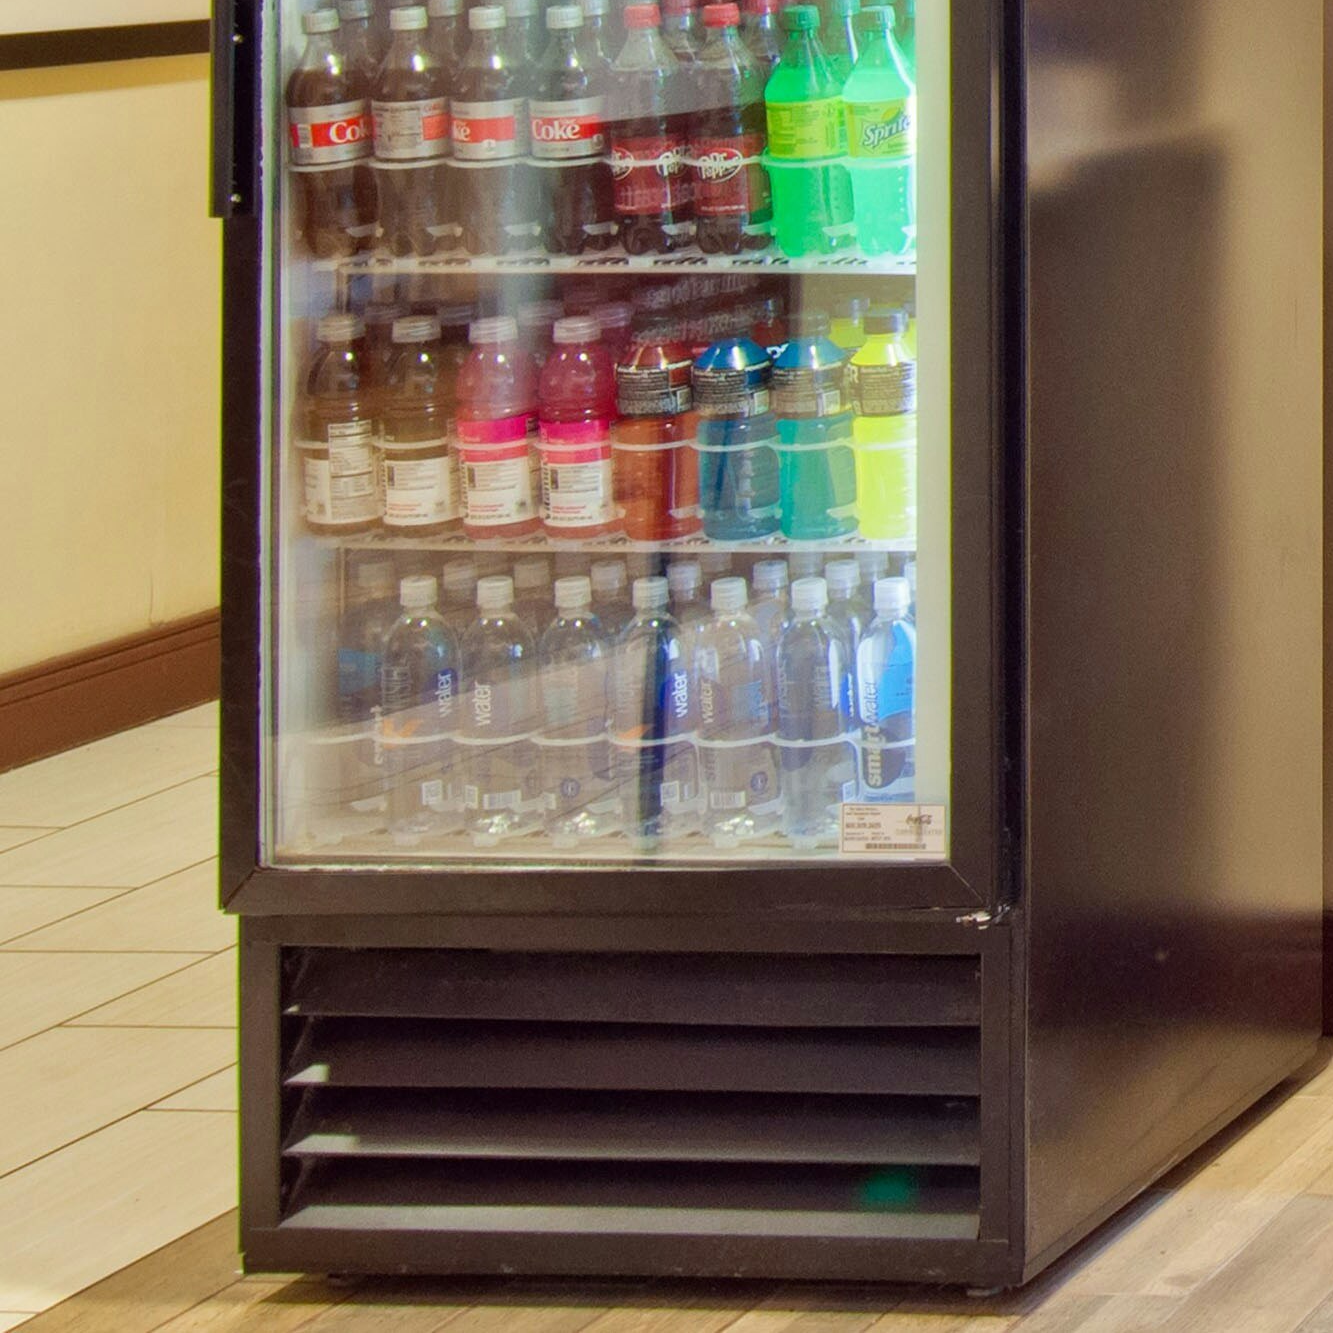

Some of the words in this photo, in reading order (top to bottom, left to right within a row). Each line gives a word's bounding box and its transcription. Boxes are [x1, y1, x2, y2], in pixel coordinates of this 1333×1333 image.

[532, 118, 580, 141] Coke
[436, 672, 452, 718] water
[472, 681, 493, 727] water
[670, 669, 689, 719] water
